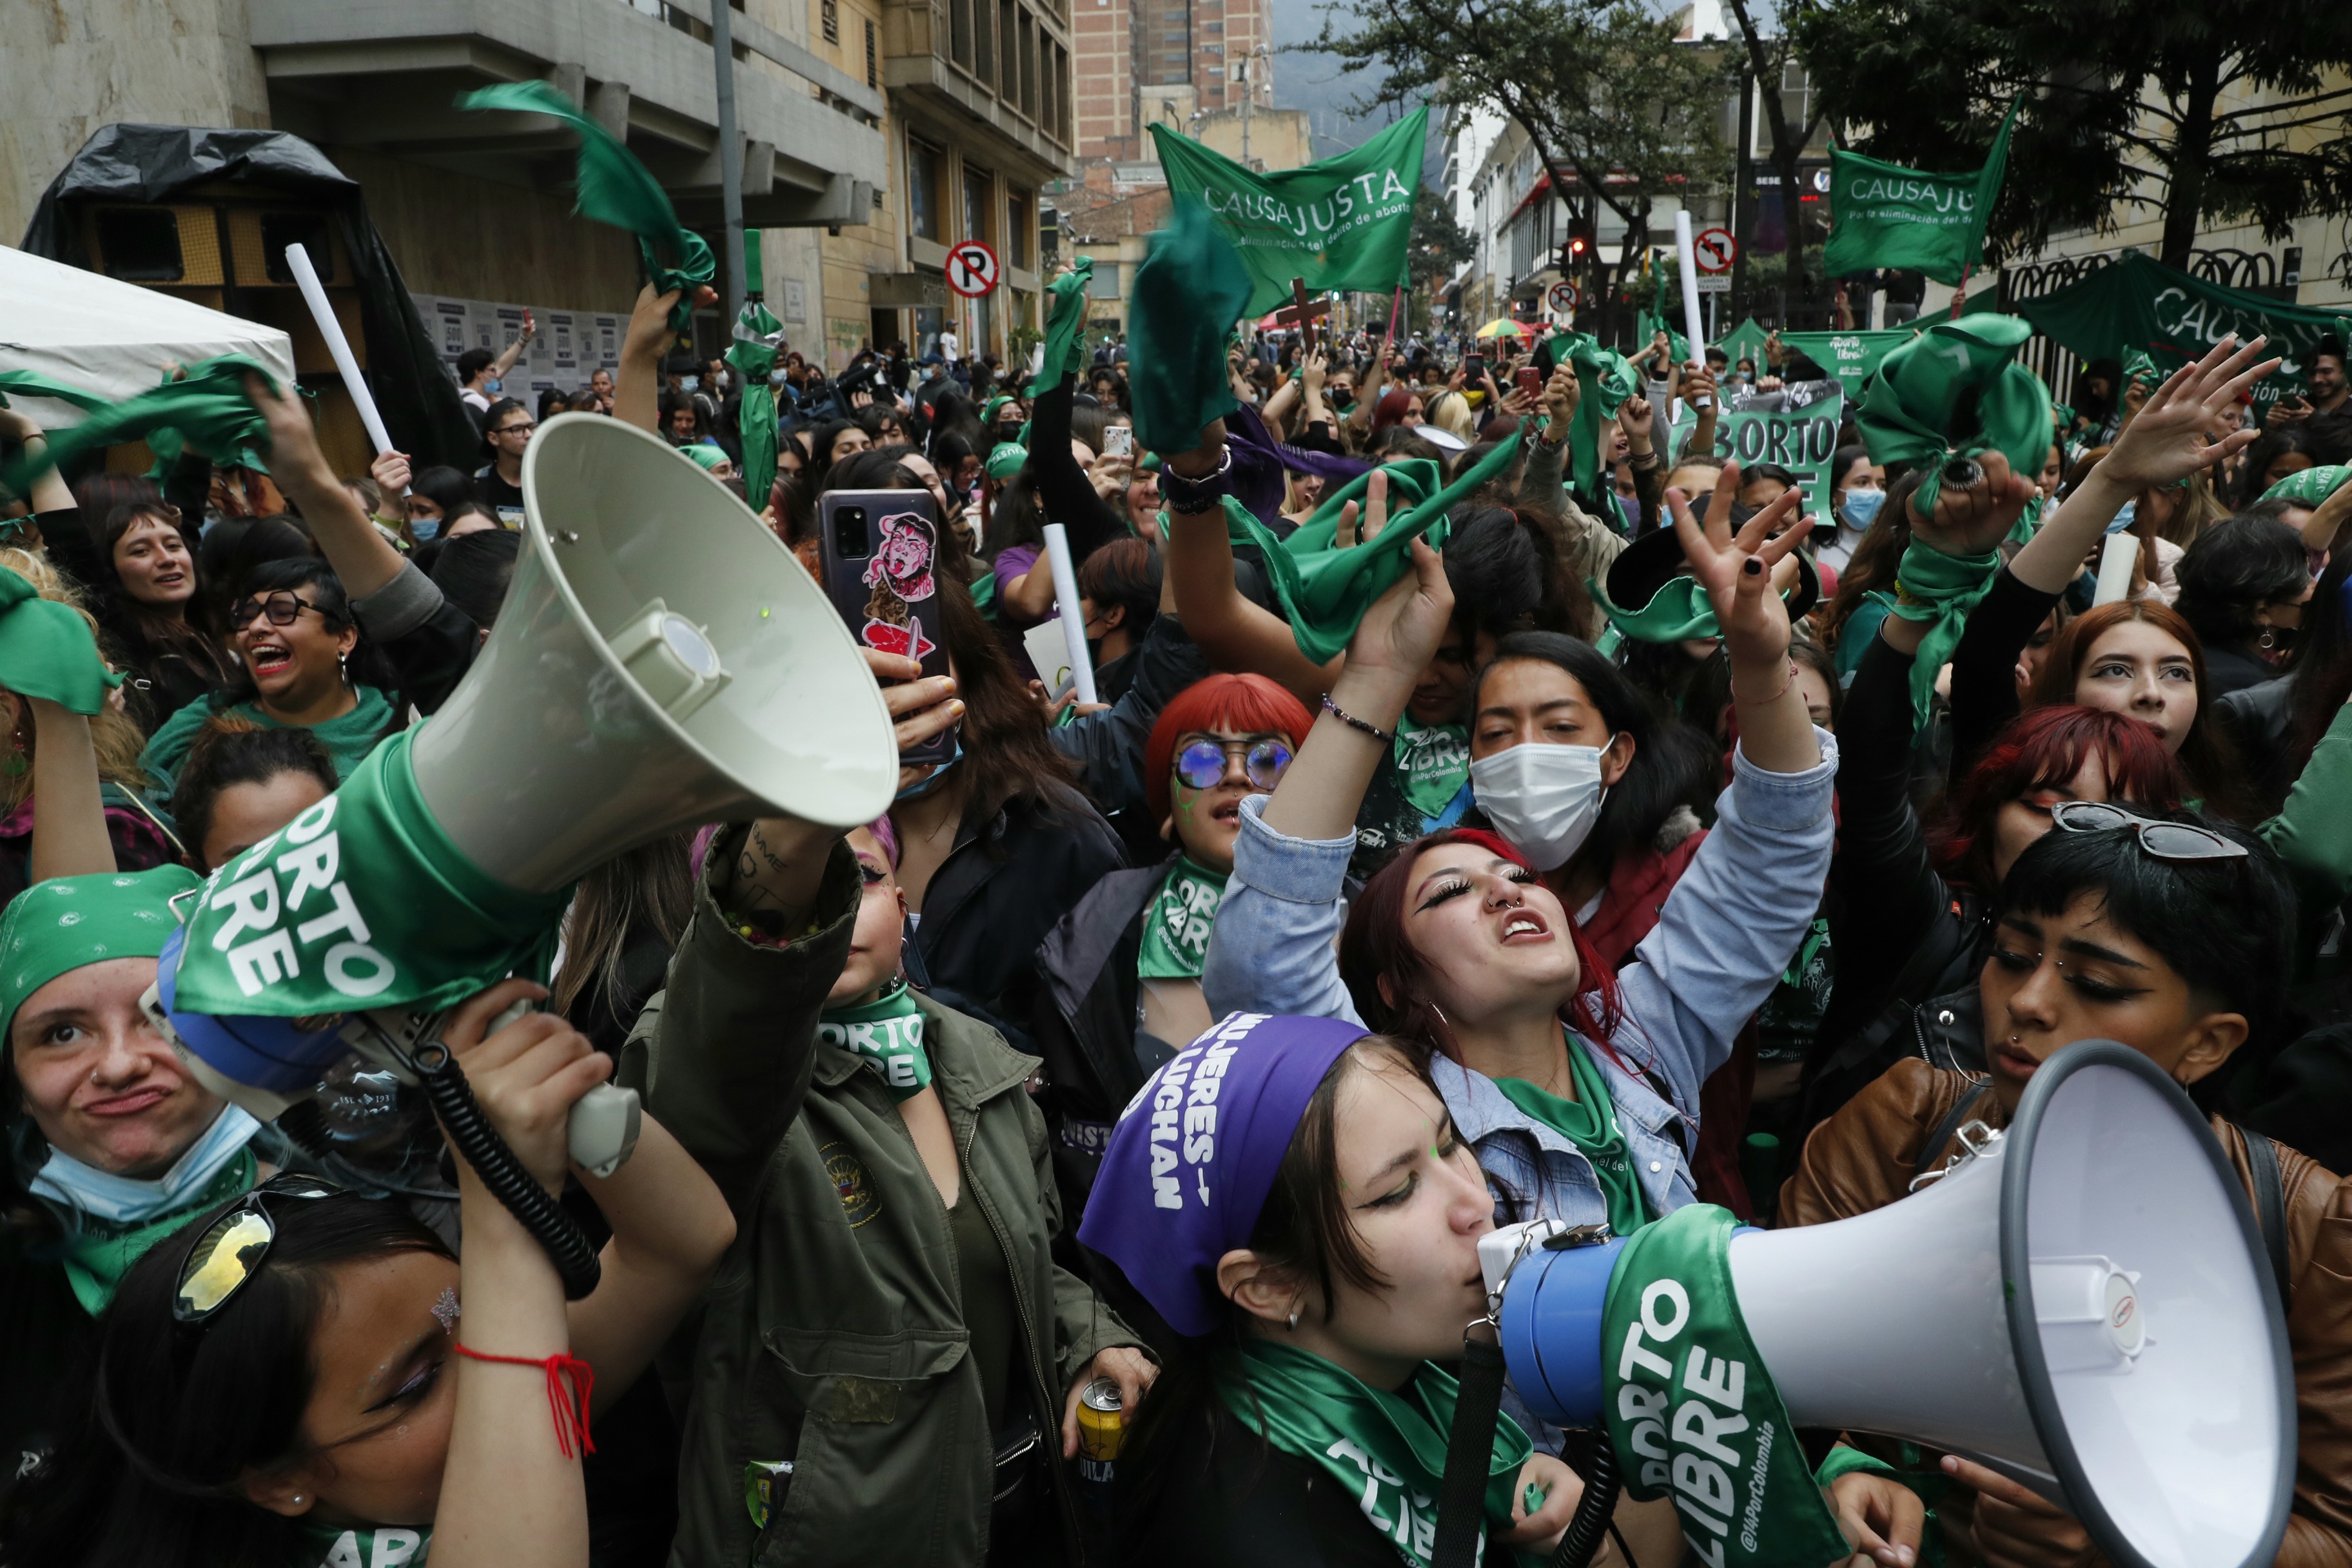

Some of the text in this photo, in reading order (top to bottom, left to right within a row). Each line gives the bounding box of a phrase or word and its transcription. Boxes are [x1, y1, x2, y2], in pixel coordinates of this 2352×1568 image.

[1307, 239, 1324, 251] del
[1327, 222, 1352, 246] delito
[1356, 210, 1371, 224] de
[1375, 201, 1411, 219] aborto
[1879, 210, 1938, 224] eliminación
[1150, 1047, 1204, 1210] LUCHAN
[1184, 1013, 1273, 1165] MUJERES
[1671, 1344, 1750, 1568] LIBRE
[1740, 1420, 1776, 1553] @14PorColombia
